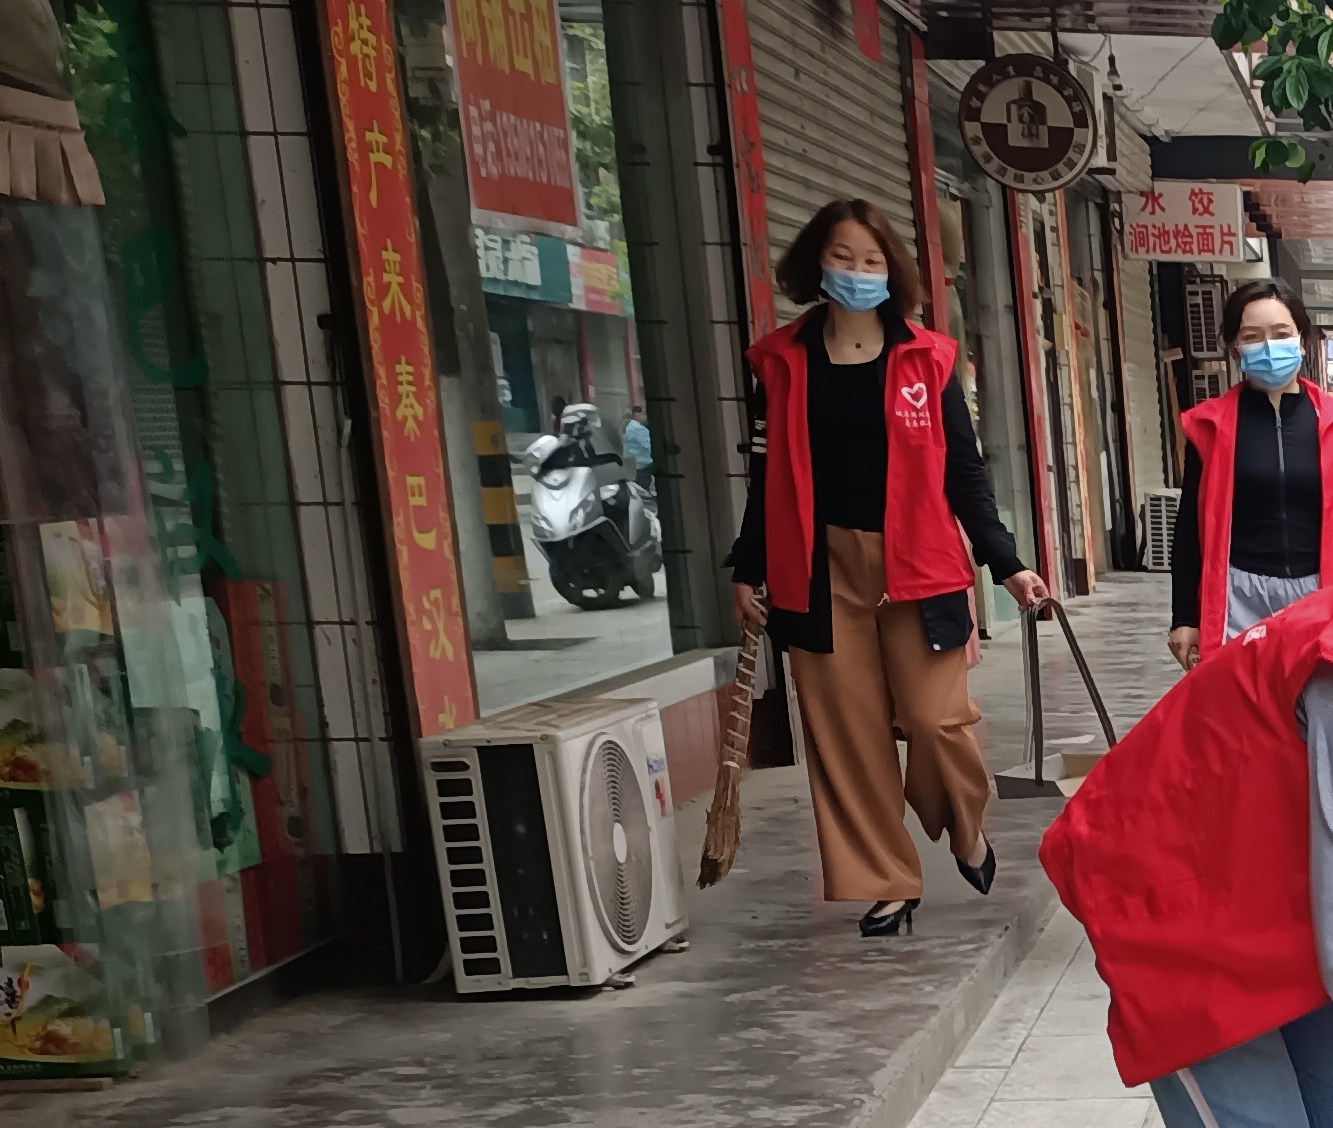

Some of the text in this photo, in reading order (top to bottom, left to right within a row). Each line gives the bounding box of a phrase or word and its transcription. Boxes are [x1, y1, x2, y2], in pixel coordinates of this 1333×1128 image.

[1139, 187, 1216, 218] 水饺
[1128, 222, 1238, 257] 涧池烩面片
